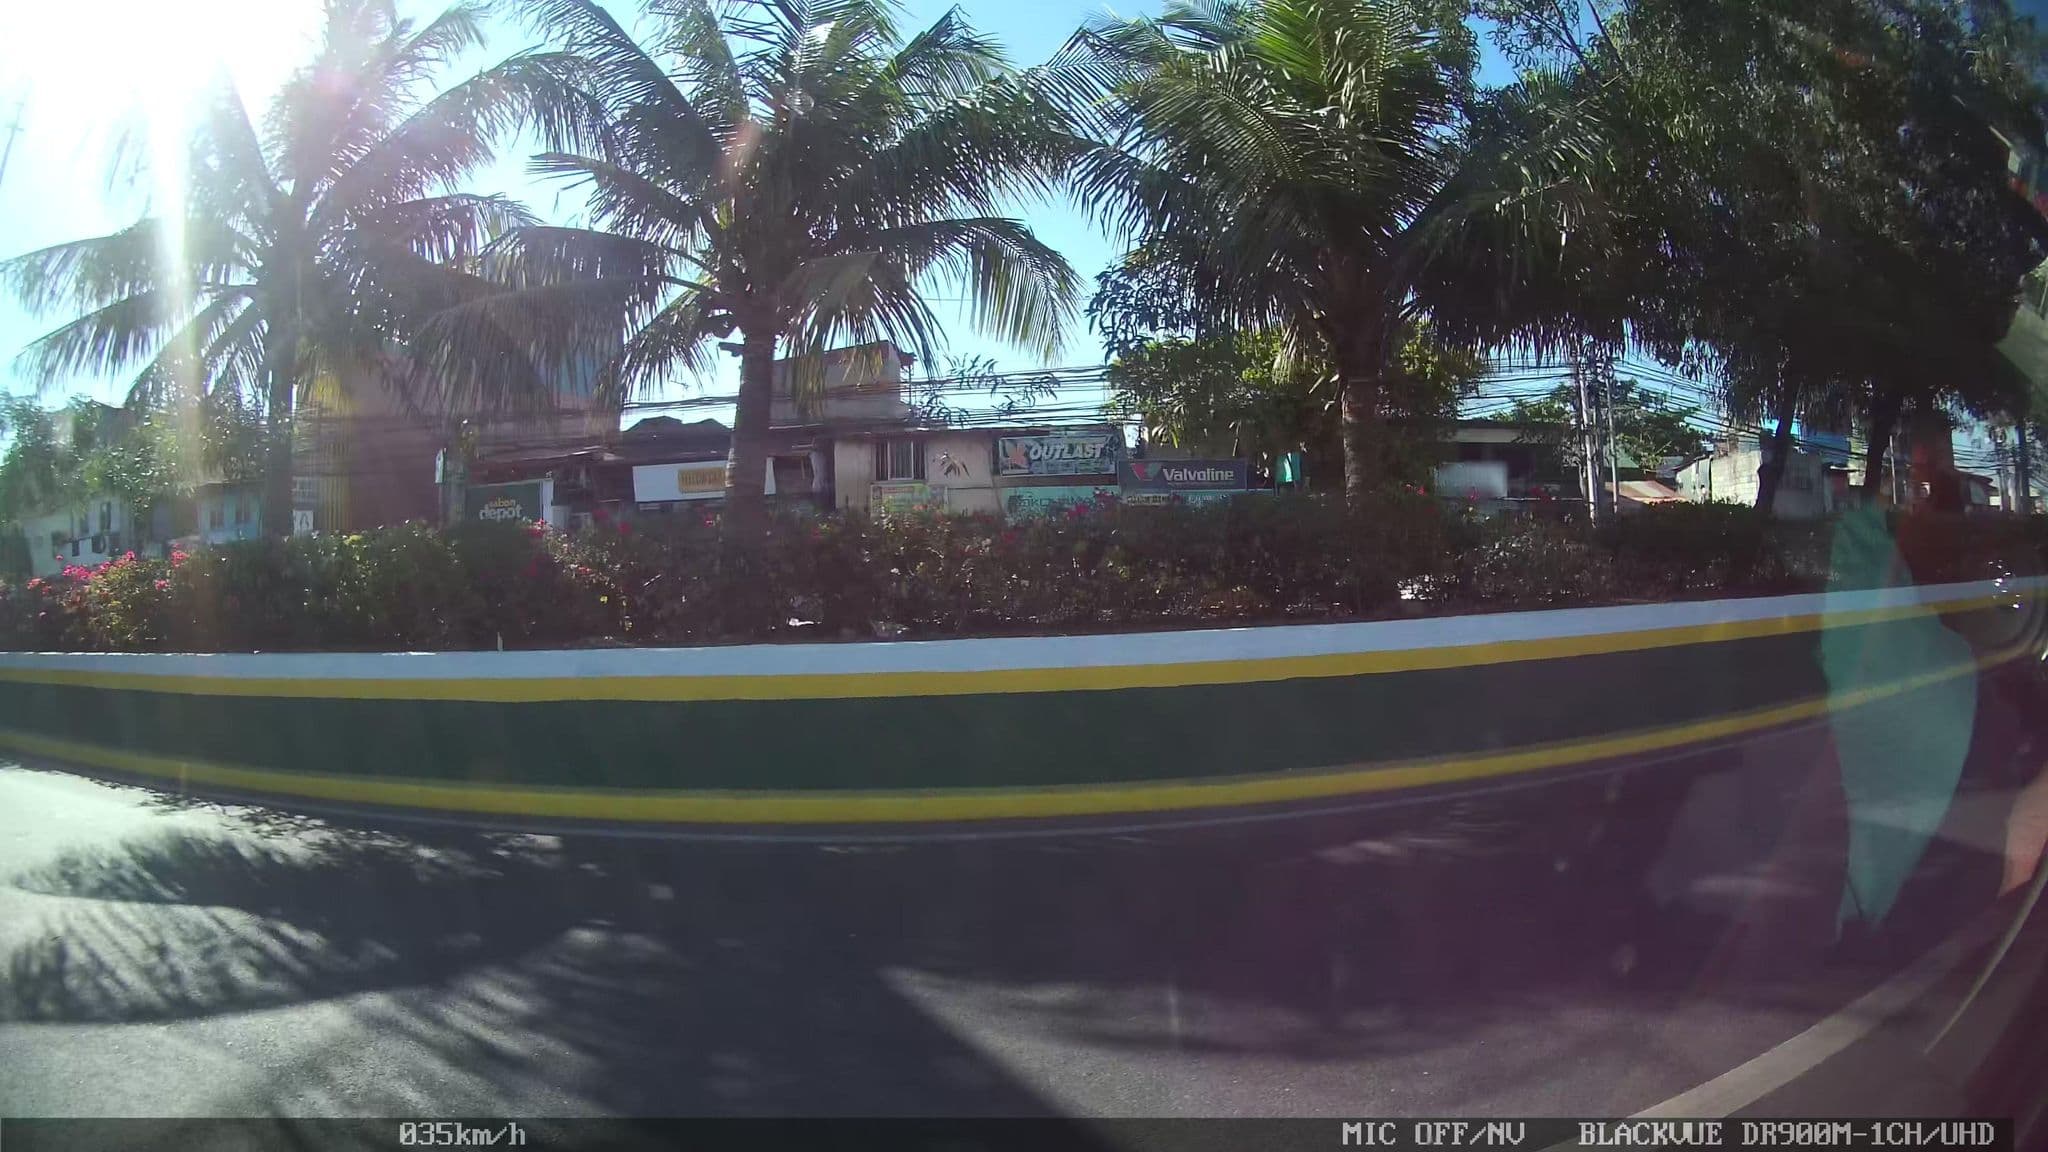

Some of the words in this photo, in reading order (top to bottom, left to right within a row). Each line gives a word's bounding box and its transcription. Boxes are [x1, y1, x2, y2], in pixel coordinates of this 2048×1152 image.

[1029, 442, 1105, 460] OUTLAST
[1163, 467, 1234, 482] Valvoline
[479, 504, 522, 523] depot
